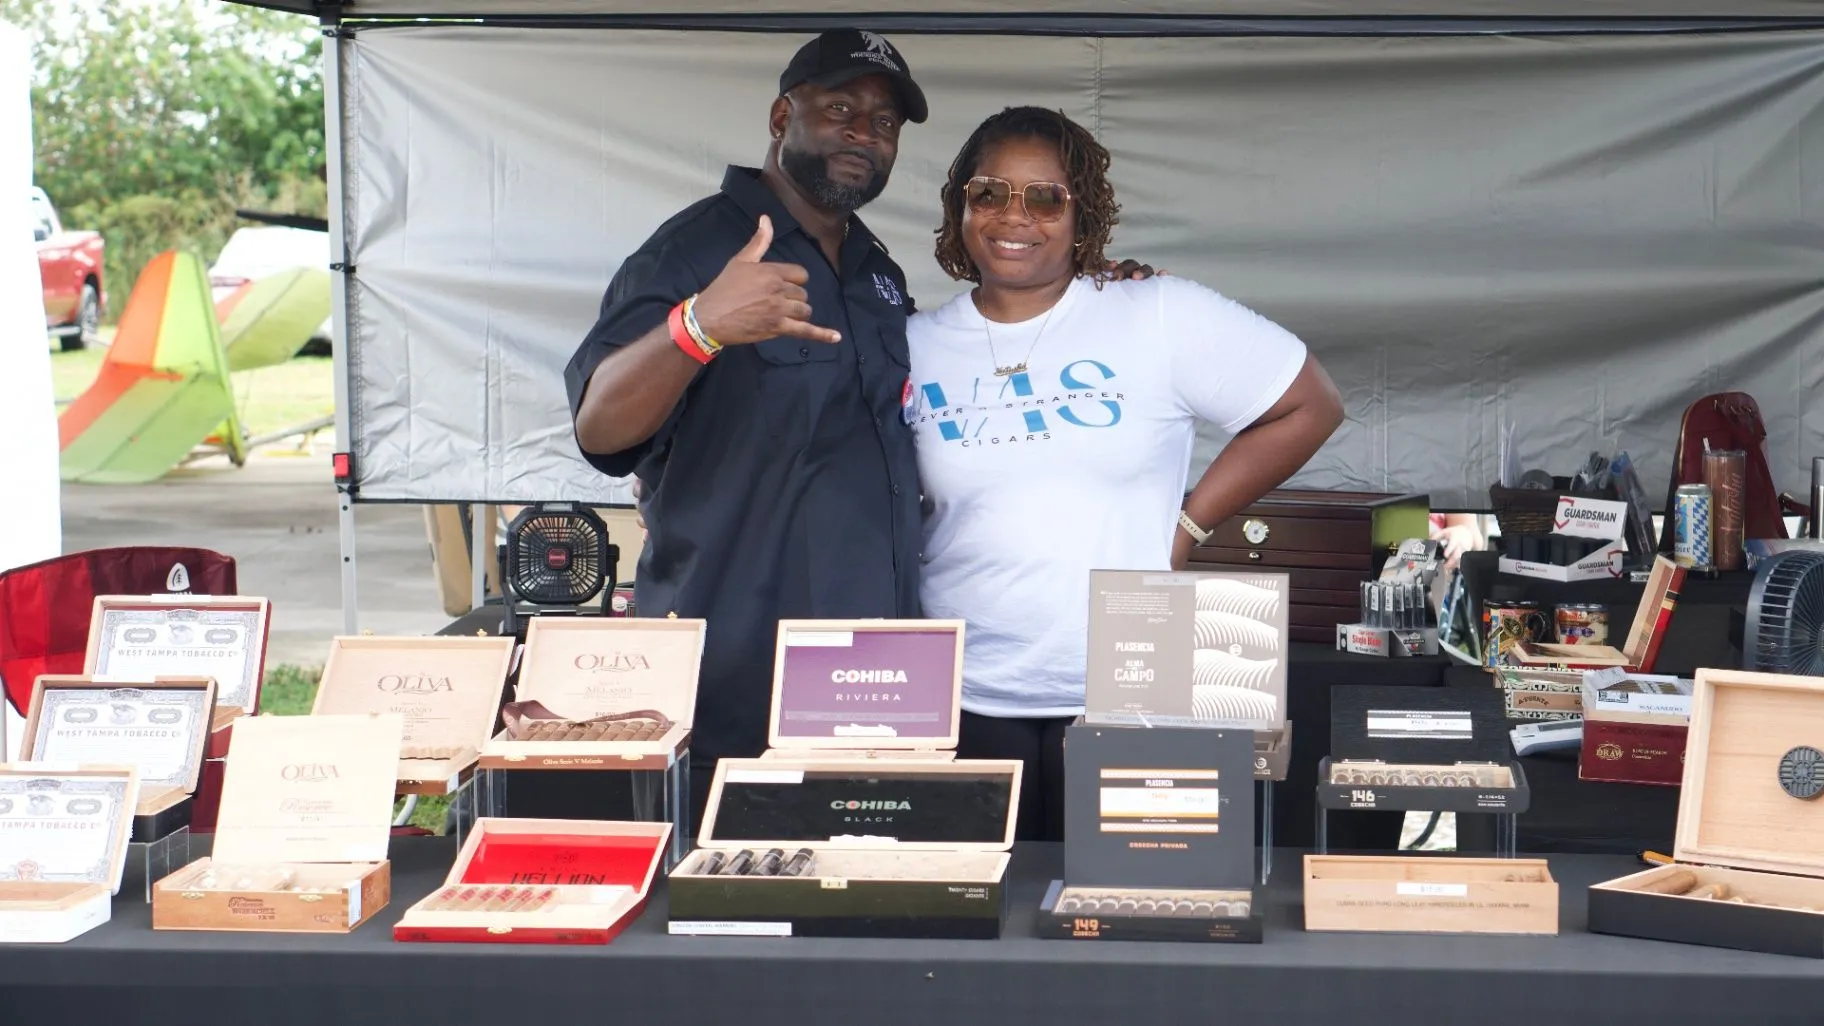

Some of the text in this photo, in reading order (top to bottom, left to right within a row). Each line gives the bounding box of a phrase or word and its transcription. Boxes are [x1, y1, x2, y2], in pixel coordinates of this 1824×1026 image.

[961, 432, 1052, 448] CIGARS
[1564, 507, 1618, 523] GUARDSMAN
[1577, 560, 1614, 570] GUARDSMAN
[1115, 641, 1155, 652] PLASENCIA
[573, 653, 651, 673] OLIVA
[831, 669, 908, 684] COHIBA
[1114, 668, 1155, 681] CAMPO
[377, 673, 454, 695] OLIVA
[836, 693, 901, 702] RIVIERA
[123, 730, 168, 738] TOBACCO
[1596, 748, 1625, 758] DRAW
[280, 763, 341, 783] OLIVA
[1145, 779, 1174, 787] PLASENCIA
[1352, 790, 1376, 802] 146
[830, 800, 912, 811] COHIBA
[2, 821, 36, 830] TAMPA
[40, 821, 90, 830] TOBACCO
[1074, 918, 1099, 931] 149
